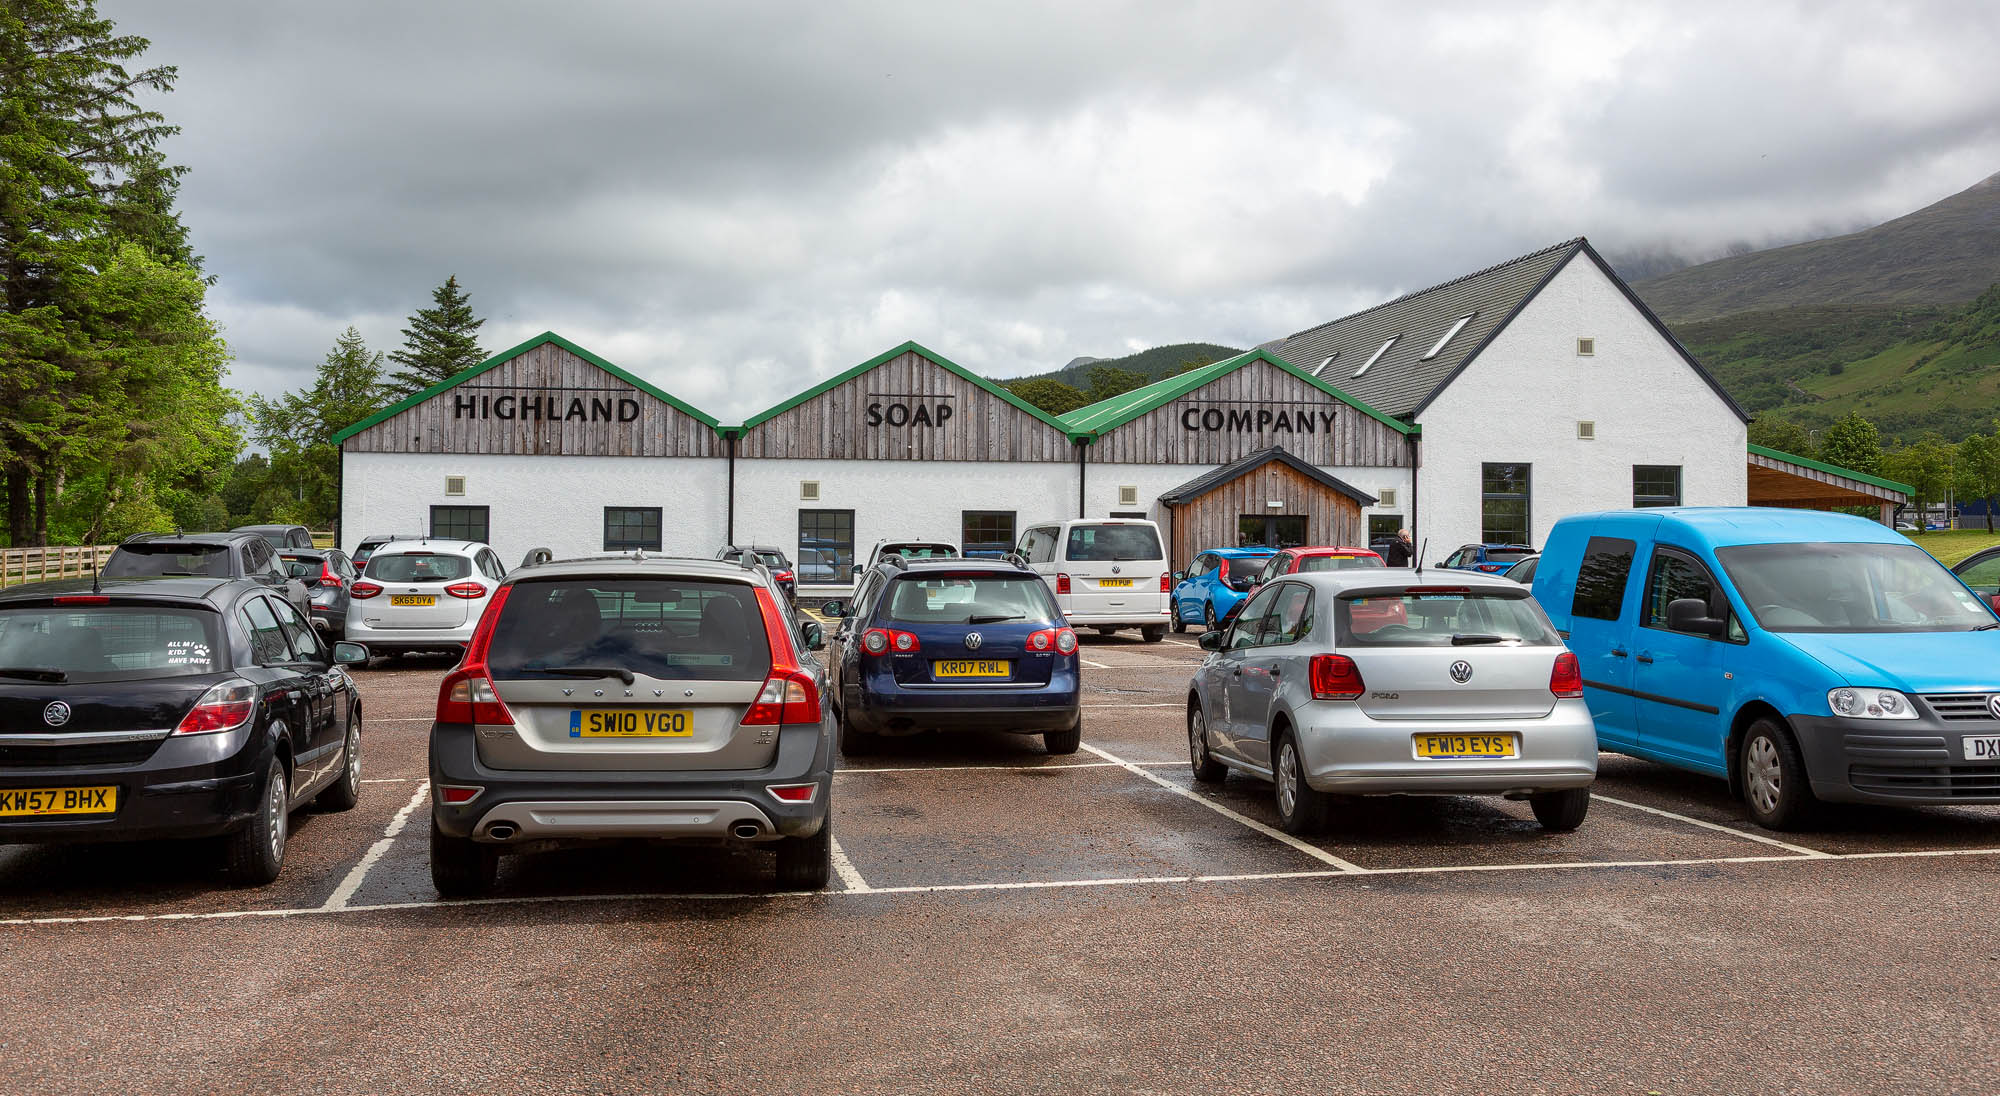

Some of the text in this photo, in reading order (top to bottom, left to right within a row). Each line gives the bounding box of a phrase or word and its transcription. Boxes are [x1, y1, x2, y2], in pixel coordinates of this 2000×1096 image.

[455, 394, 640, 423] HIGHLAND
[867, 403, 953, 428] SOAP
[1181, 407, 1338, 434] COMPANY
[394, 596, 432, 605] SK65 DYA
[941, 661, 1004, 674] KR07 RWL
[562, 688, 694, 697] VOLVO
[589, 712, 686, 733] SW10 VGO
[1427, 736, 1504, 753] FW13 EYS
[0, 788, 108, 811] KW57 BHX
